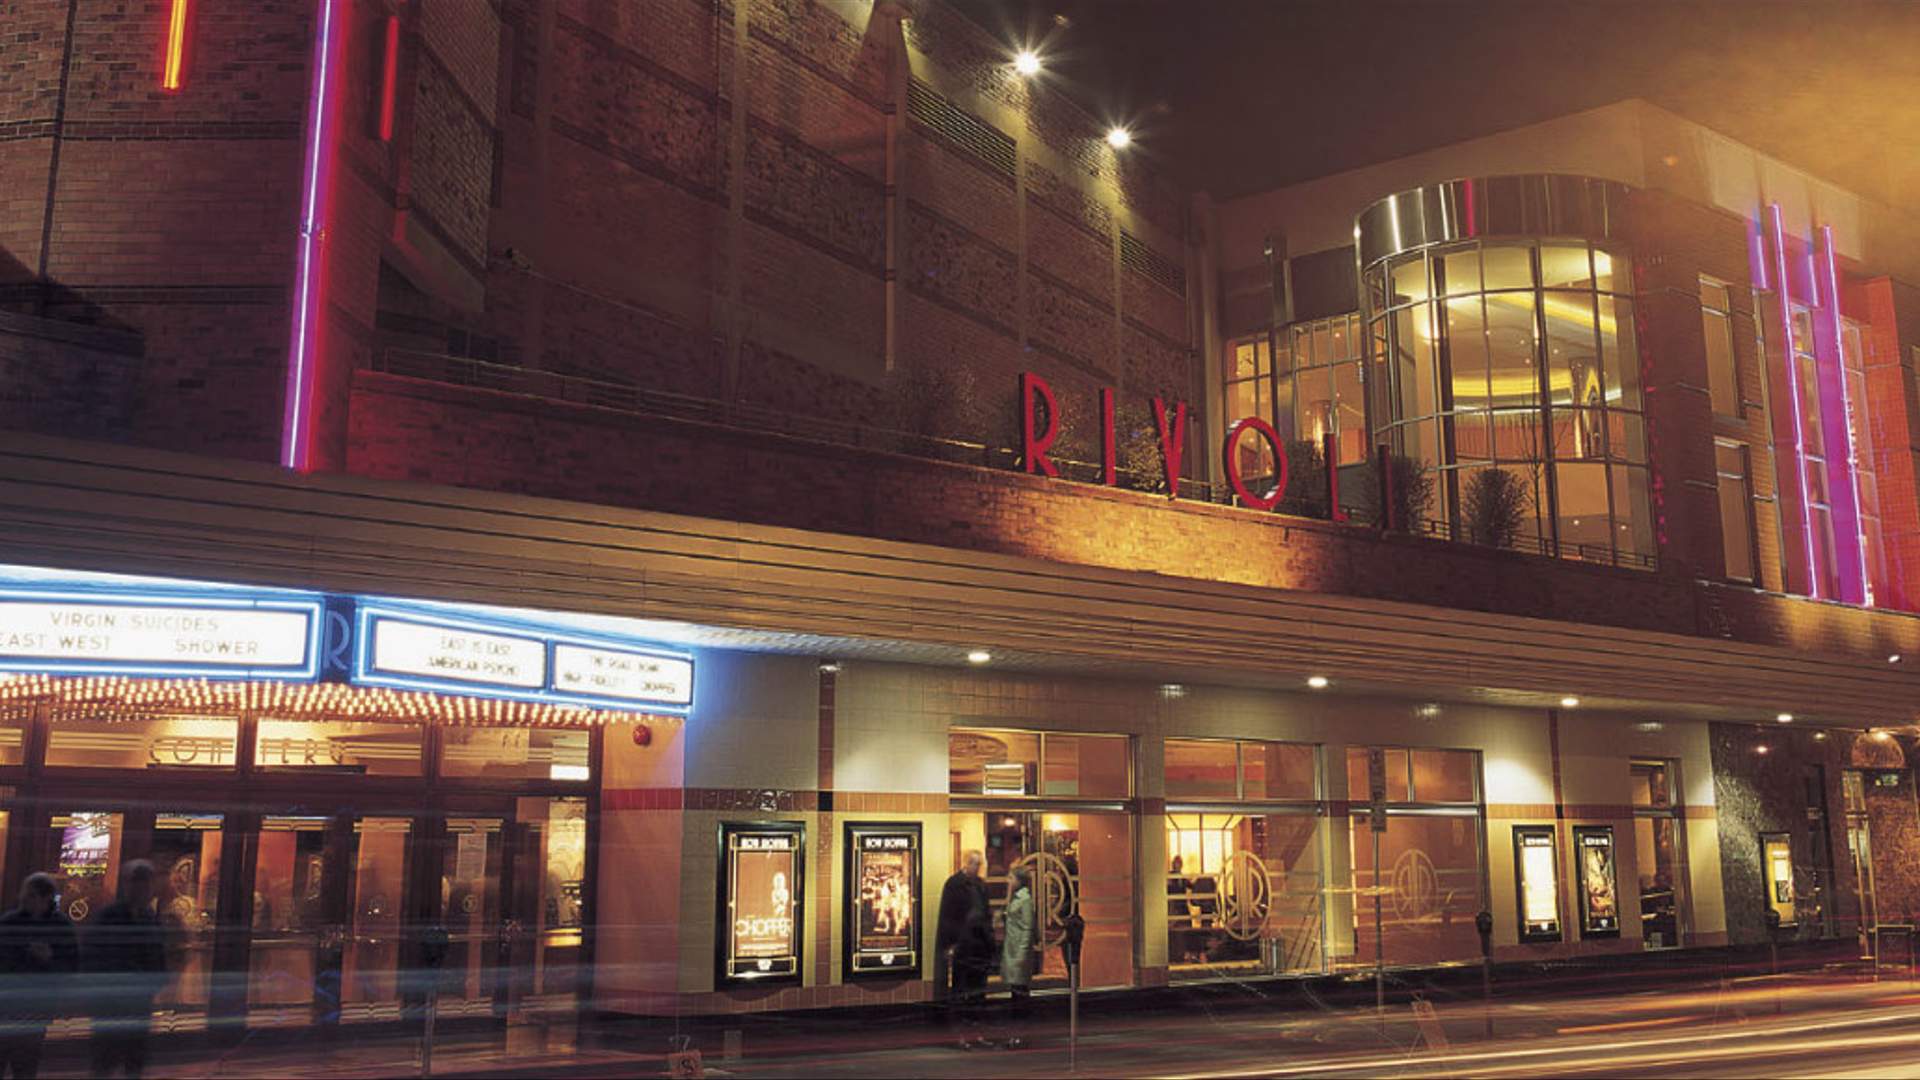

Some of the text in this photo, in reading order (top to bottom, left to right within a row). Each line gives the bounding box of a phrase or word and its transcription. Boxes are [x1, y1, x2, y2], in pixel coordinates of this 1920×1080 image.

[1019, 371, 1392, 531] RIVOLI
[50, 611, 220, 632] VIRGIN SUICIDES
[58, 634, 111, 651] WEST
[175, 639, 259, 655] SHOWER
[324, 609, 350, 669] R
[735, 917, 790, 937] CHOPPER
